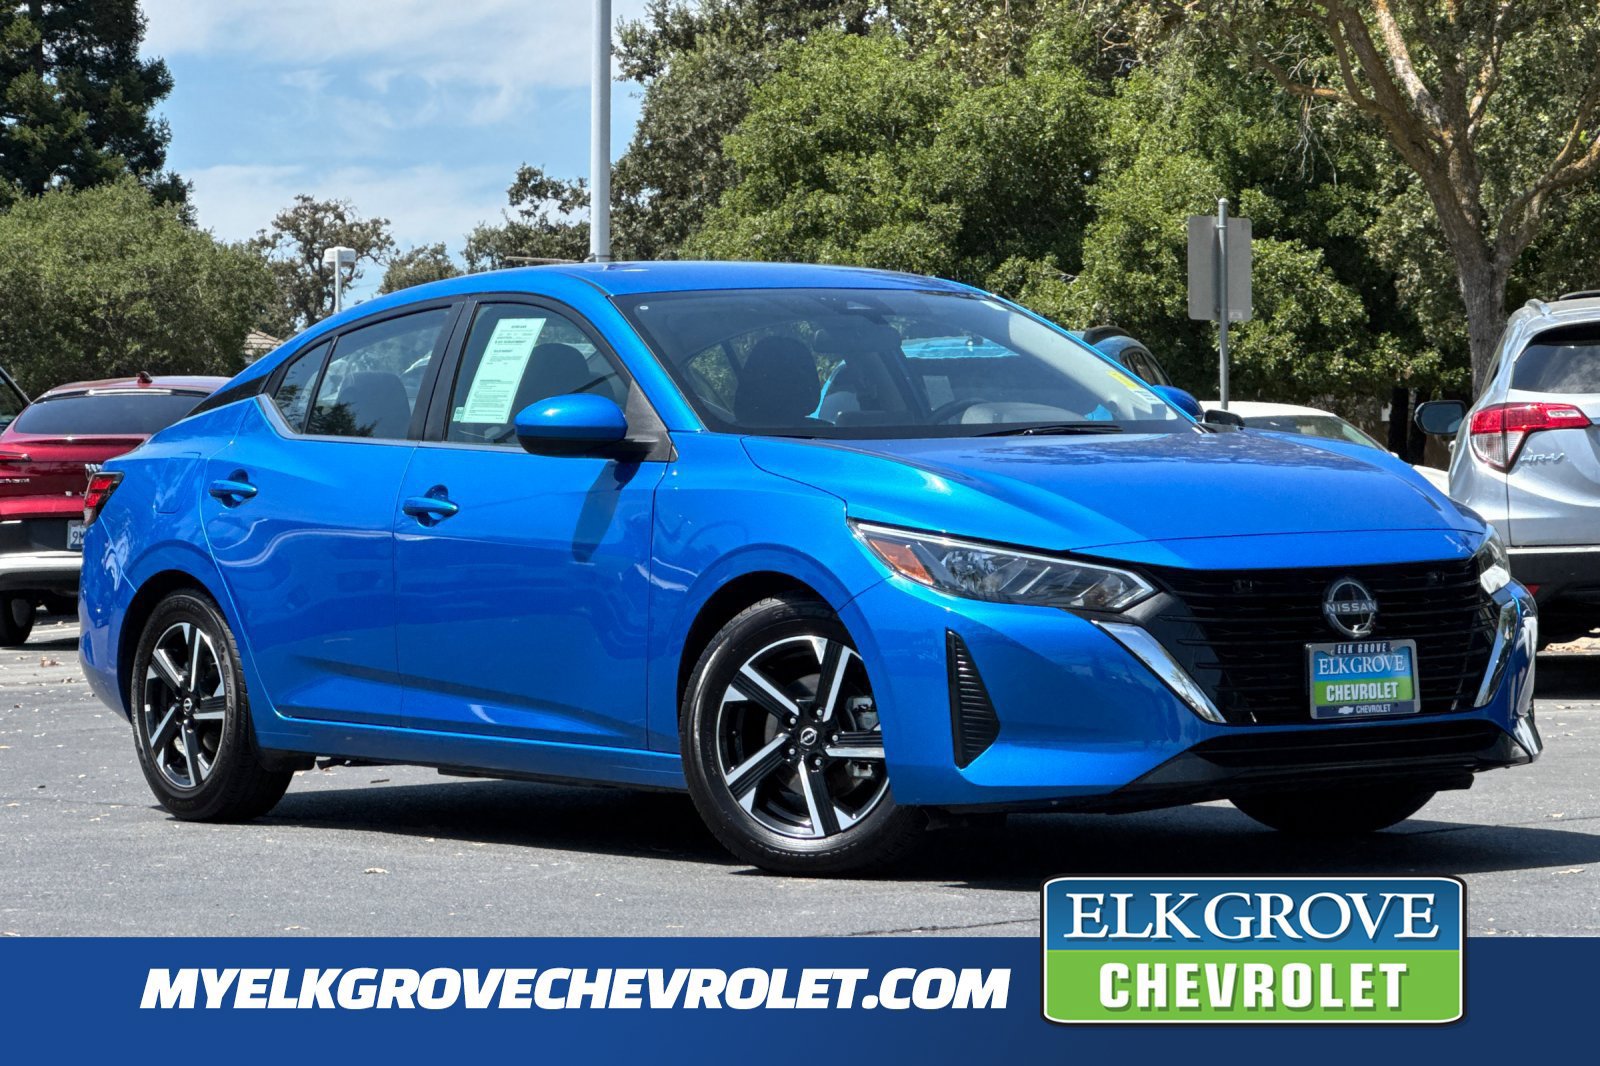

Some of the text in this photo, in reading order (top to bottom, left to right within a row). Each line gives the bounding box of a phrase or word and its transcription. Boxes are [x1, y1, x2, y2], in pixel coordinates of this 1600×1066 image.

[1326, 602, 1377, 613] NISSAN
[1337, 642, 1387, 654] ELK GROVE
[1318, 654, 1405, 675] ELK GROVE
[1326, 682, 1398, 702] CHEVROLET
[1356, 704, 1391, 713] CHEVROLET
